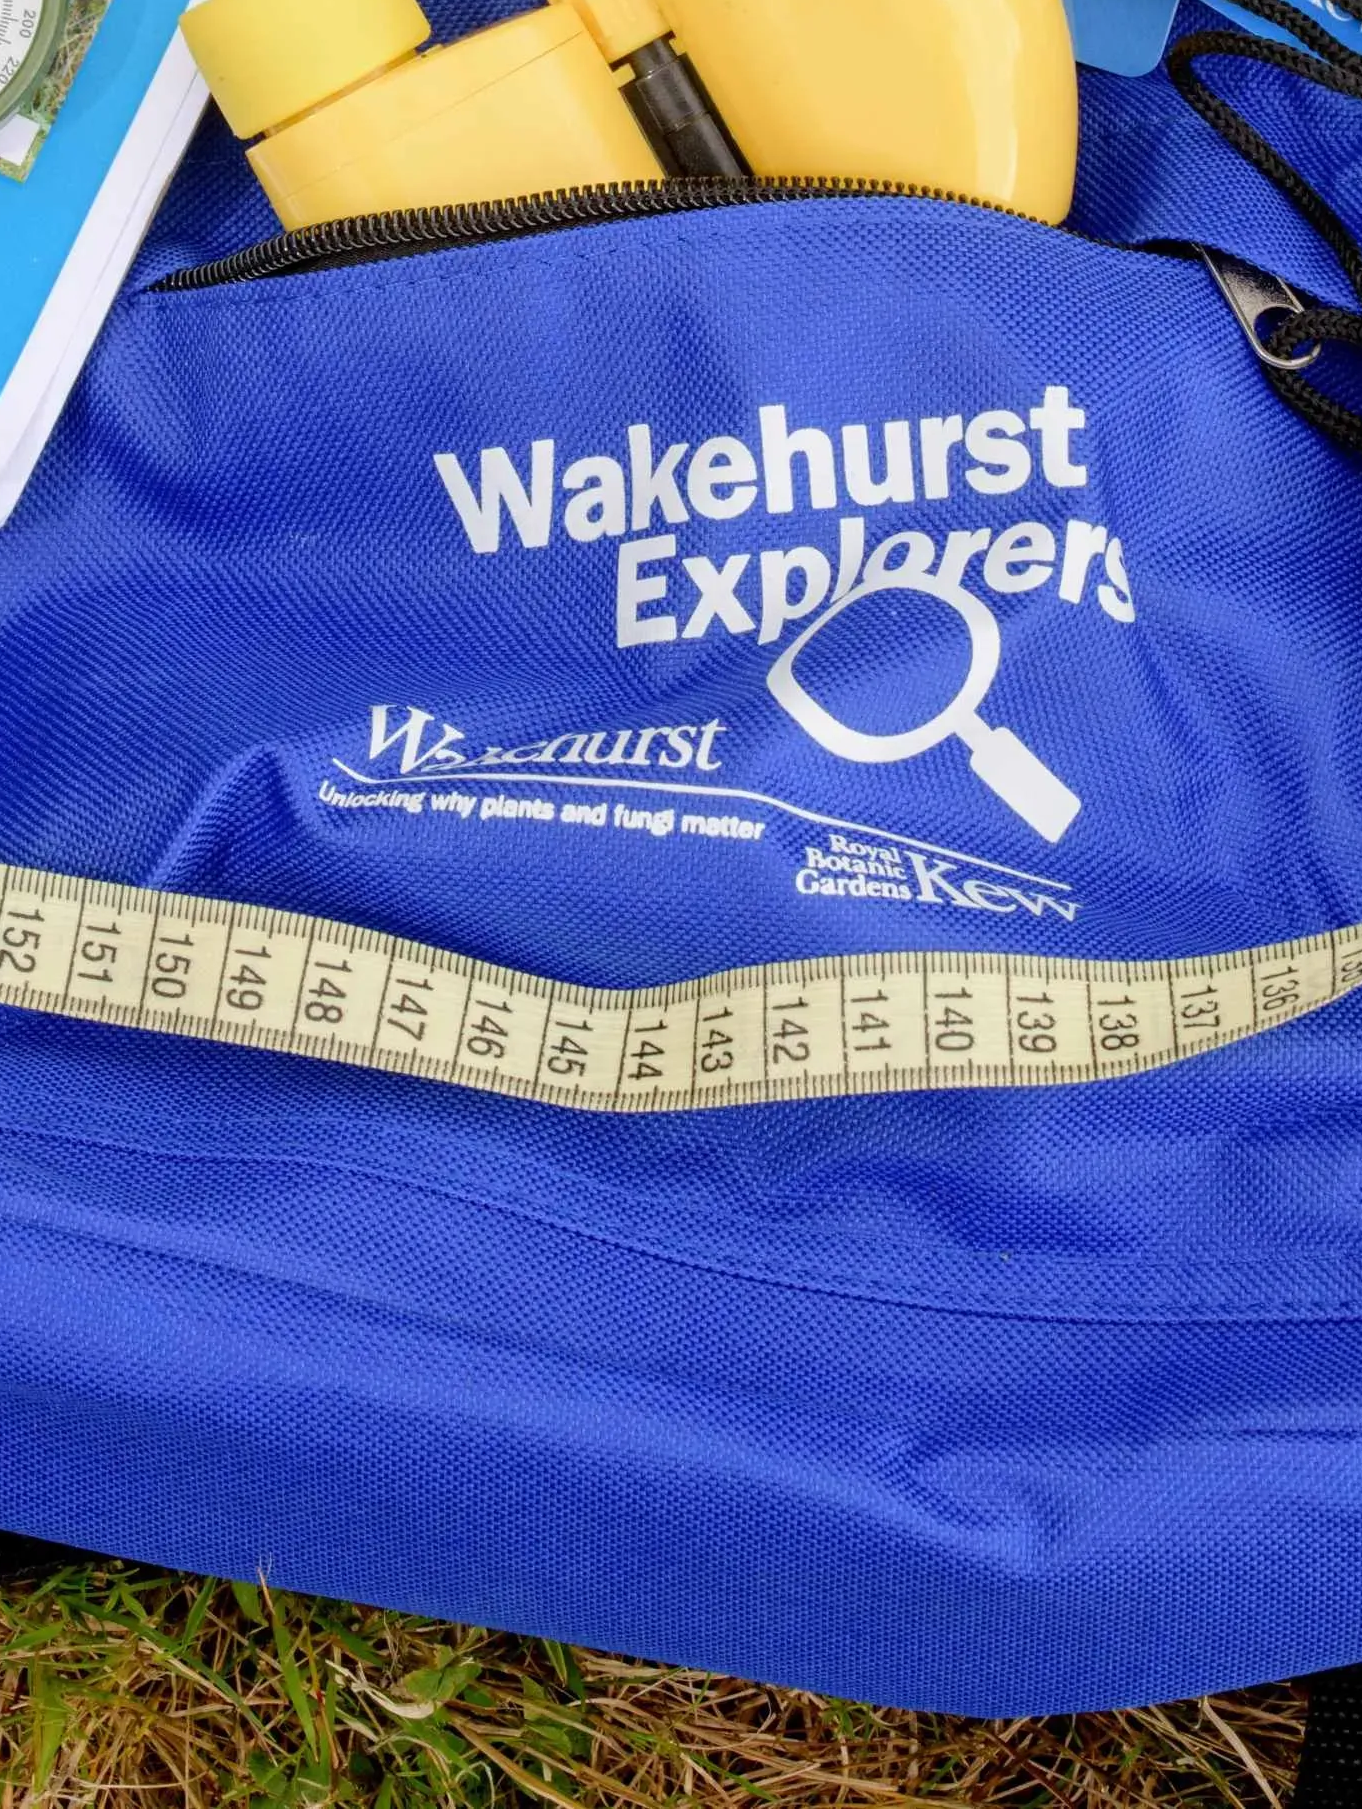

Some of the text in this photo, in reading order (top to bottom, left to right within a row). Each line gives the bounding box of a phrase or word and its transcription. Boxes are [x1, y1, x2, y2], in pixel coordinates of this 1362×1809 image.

[432, 384, 1088, 555] Wakehurst
[615, 516, 1136, 649] Explorers
[318, 779, 766, 841] Unlocking why plants and fungi matter
[804, 845, 908, 881] Botanic
[828, 833, 902, 864] Royal
[795, 849, 1084, 923] Gardens Kew
[76, 921, 122, 984] 151
[150, 932, 195, 1000] 150
[225, 944, 273, 1012] 149
[304, 958, 354, 1025] 148
[386, 973, 435, 1043] 147
[466, 995, 515, 1060] 146
[547, 1014, 594, 1079] 145
[625, 1017, 669, 1082] 144
[700, 1005, 735, 1074] 143
